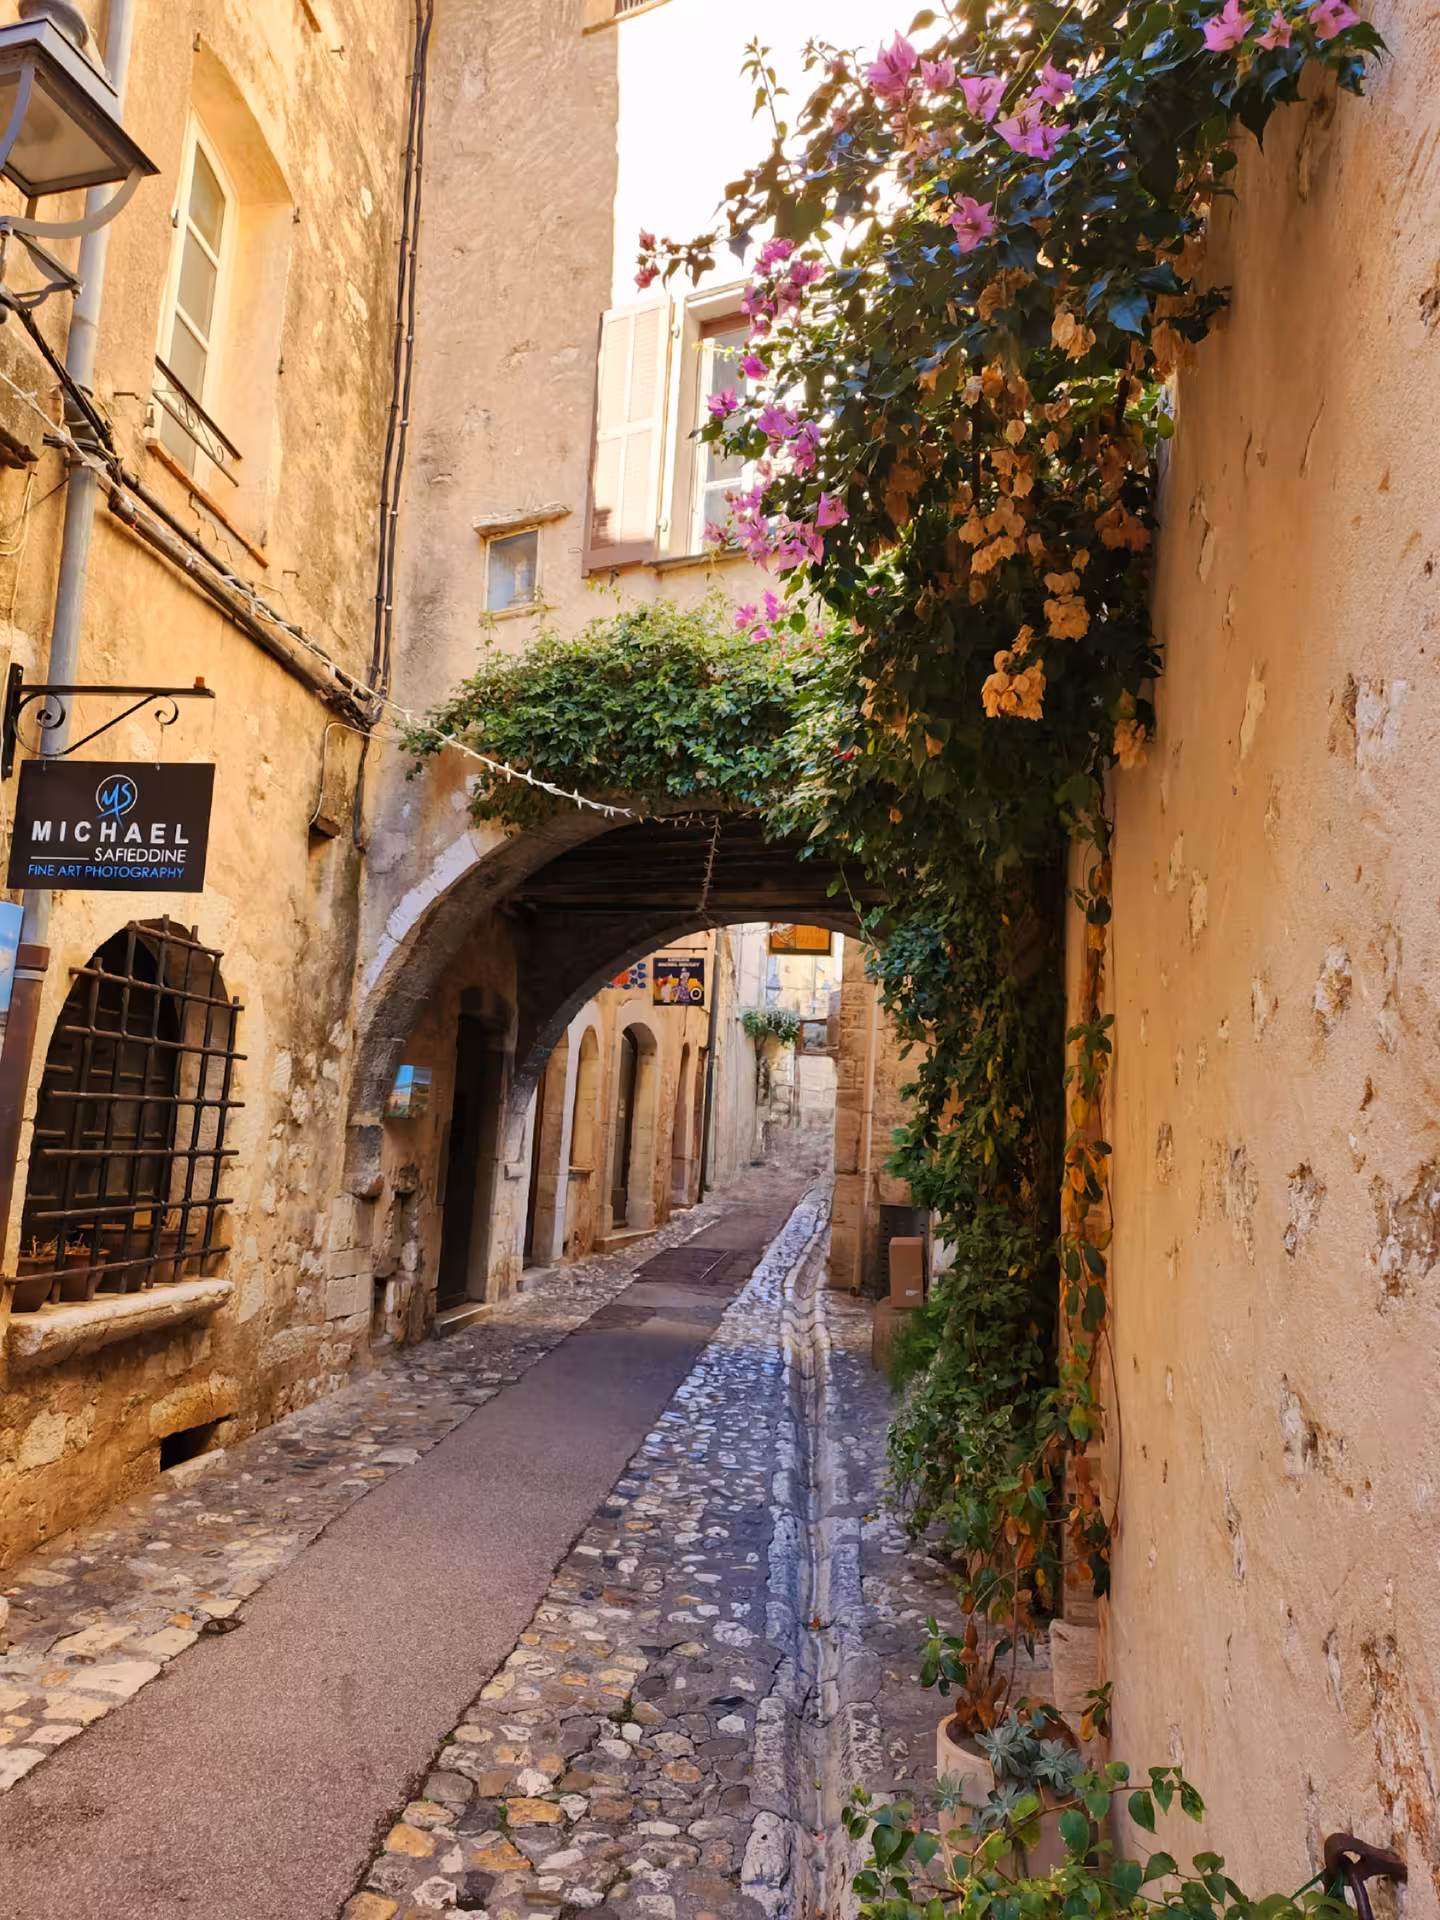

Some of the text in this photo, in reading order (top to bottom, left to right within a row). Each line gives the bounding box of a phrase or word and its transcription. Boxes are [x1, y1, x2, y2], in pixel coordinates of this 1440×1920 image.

[31, 821, 189, 844] MICHAEL
[94, 847, 187, 863] SAFIEDDINE
[28, 864, 185, 879] FINE ART PHOTOGRAPHY
